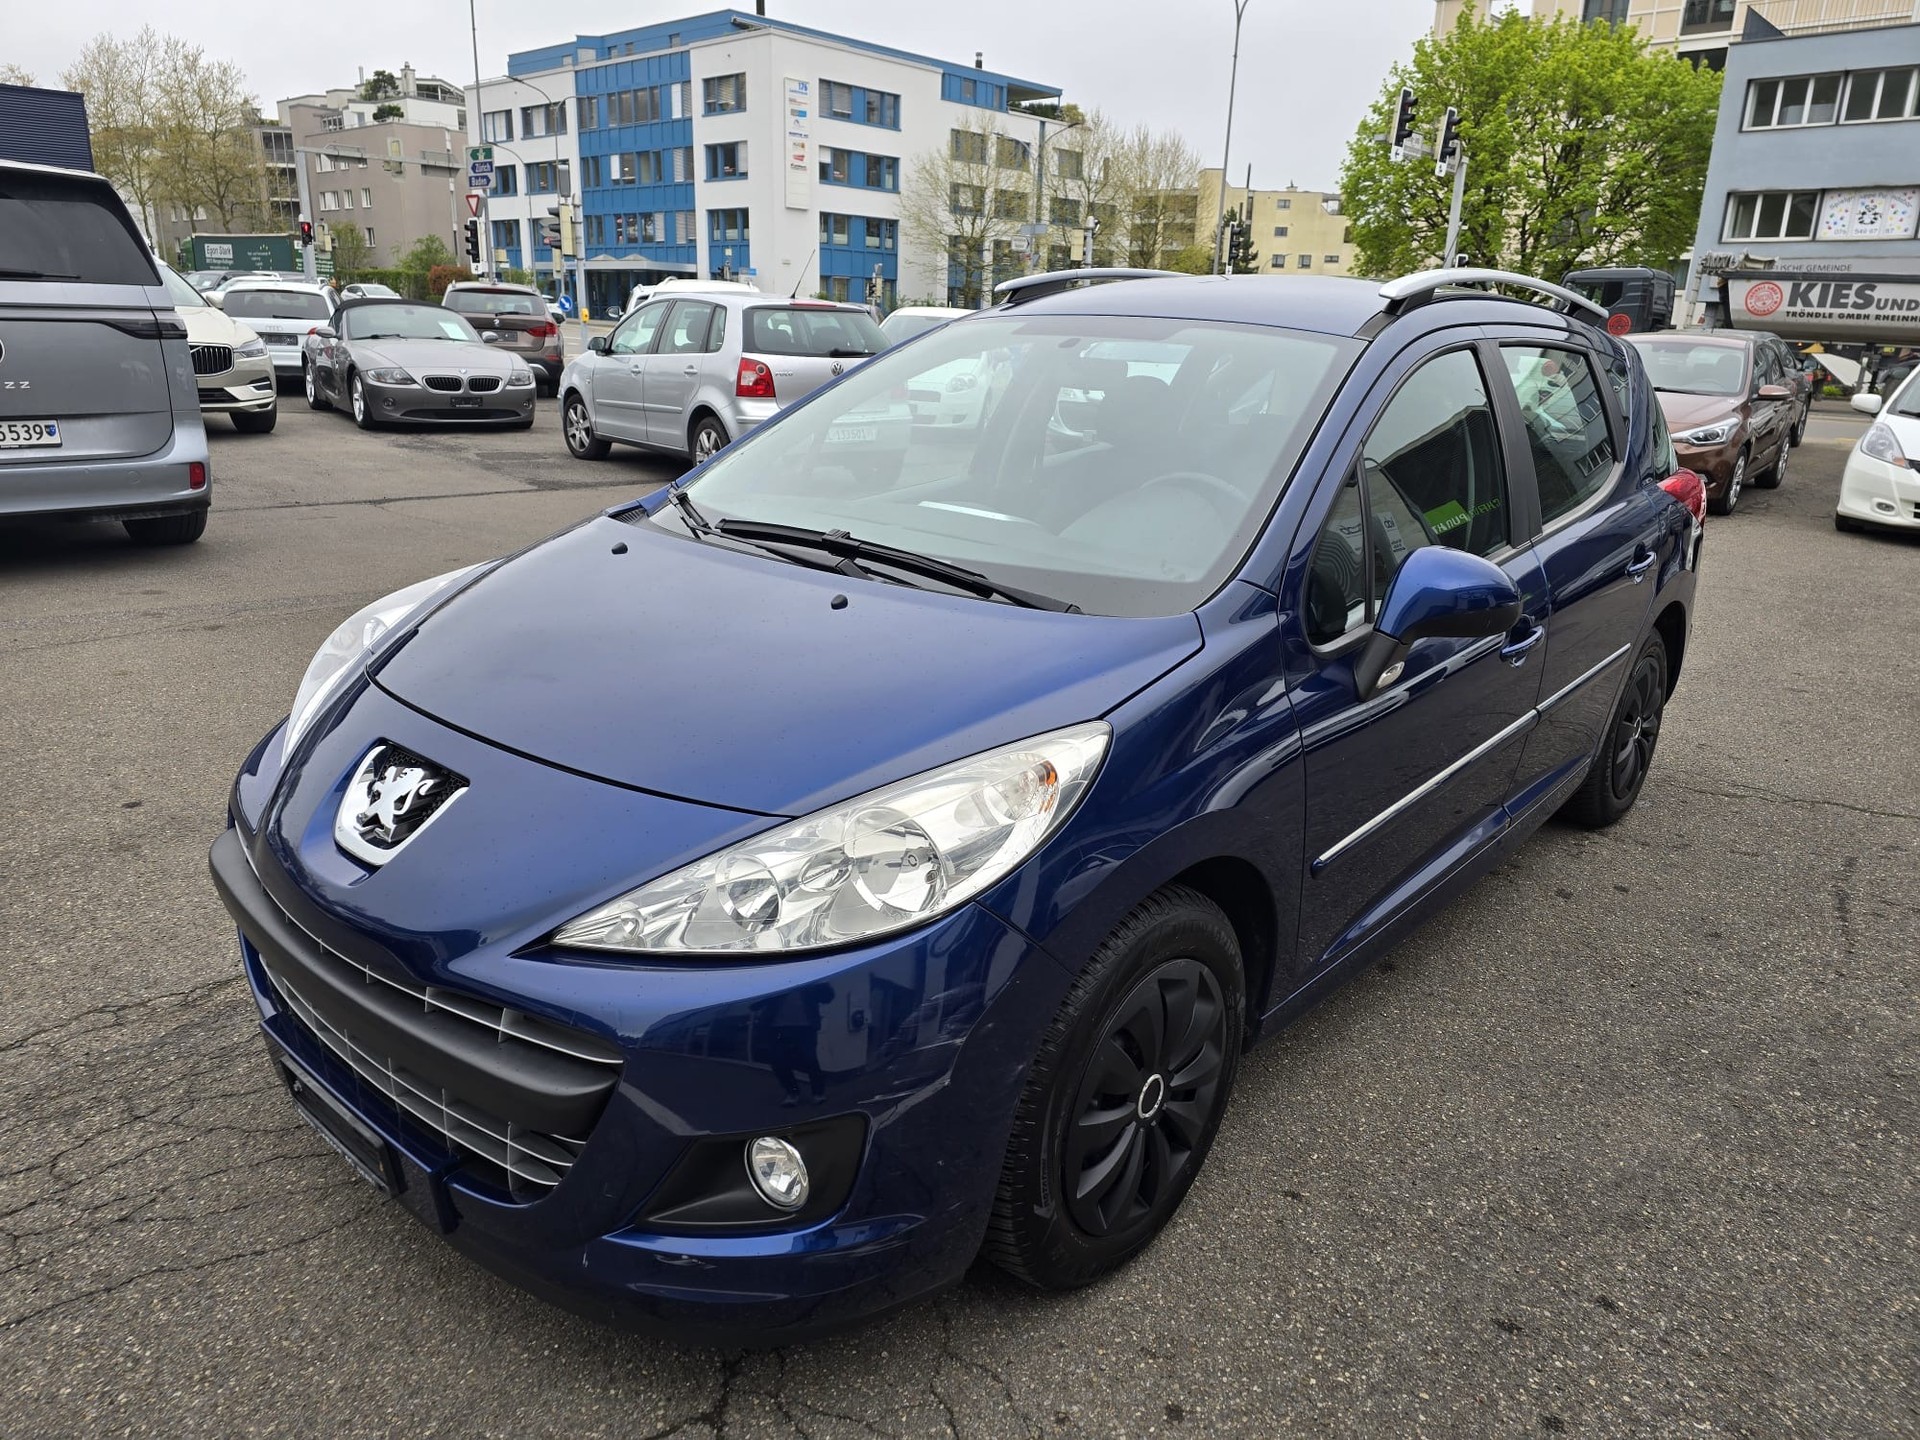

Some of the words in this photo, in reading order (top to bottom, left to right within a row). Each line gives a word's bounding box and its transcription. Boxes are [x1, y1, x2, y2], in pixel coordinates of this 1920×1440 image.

[475, 162, 491, 173] Zürich
[471, 176, 487, 187] Baden
[206, 245, 218, 257] Egon
[1787, 282, 1877, 310] KIES
[1875, 298, 1920, 312] UND
[1785, 308, 1834, 320] TRÖNDLE
[1837, 312, 1871, 321] GMBH
